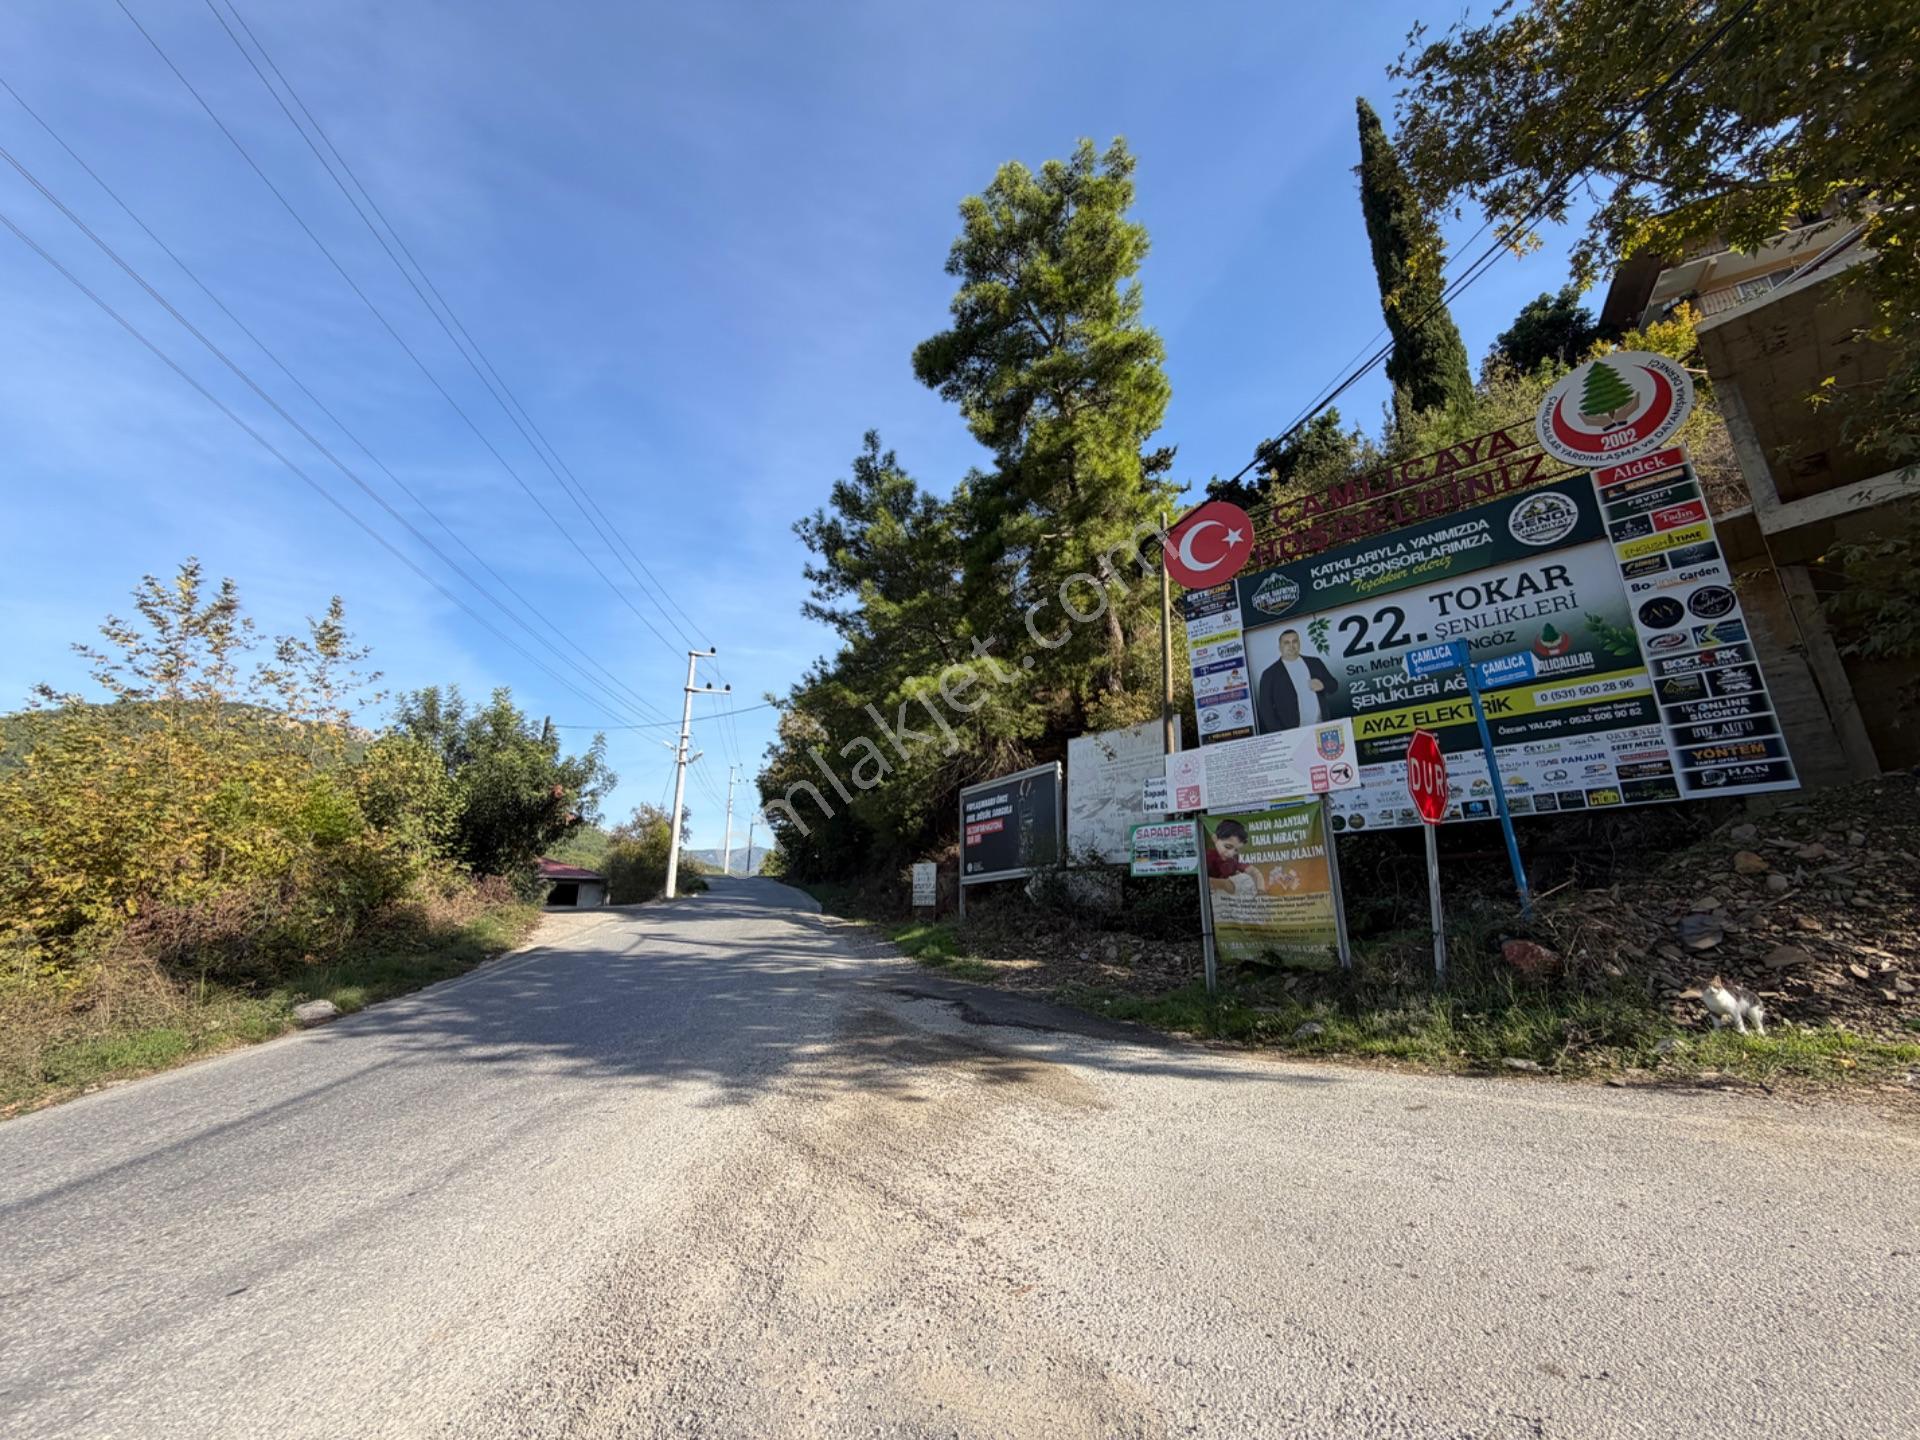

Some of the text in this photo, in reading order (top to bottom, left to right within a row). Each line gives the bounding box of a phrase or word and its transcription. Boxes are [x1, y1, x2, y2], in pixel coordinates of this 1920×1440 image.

[1601, 428, 1640, 450] 2002
[1561, 445, 1640, 462] YARDIMLAŞMA
[1614, 456, 1667, 481] Aldek
[1311, 518, 1490, 578] KATKILARIYLA YANIMIZDA
[1312, 532, 1493, 590] OLAN SPONSORLARIMIZA
[1680, 566, 1720, 581] Garden
[1429, 564, 1574, 617] TOKAR
[1434, 590, 1580, 641] ŞENLİKLERİ
[1338, 606, 1428, 658] 22.
[1411, 645, 1453, 666] ÇAMLICA
[1482, 656, 1525, 677] ÇAMLICA
[1346, 664, 1368, 676] Sn.
[1352, 679, 1440, 712] ŞENLİKLERİ
[1541, 679, 1634, 702] 0 (531) 500 28 96
[1362, 693, 1513, 734] AYAZ ELEKTRİK
[1498, 725, 1527, 735] Özcan
[1528, 718, 1562, 731] YALÇIN
[1410, 757, 1445, 797] DUR
[1727, 764, 1770, 776] HAN
[1136, 824, 1192, 839] SAPADERE
[1251, 834, 1272, 847] TAHA
